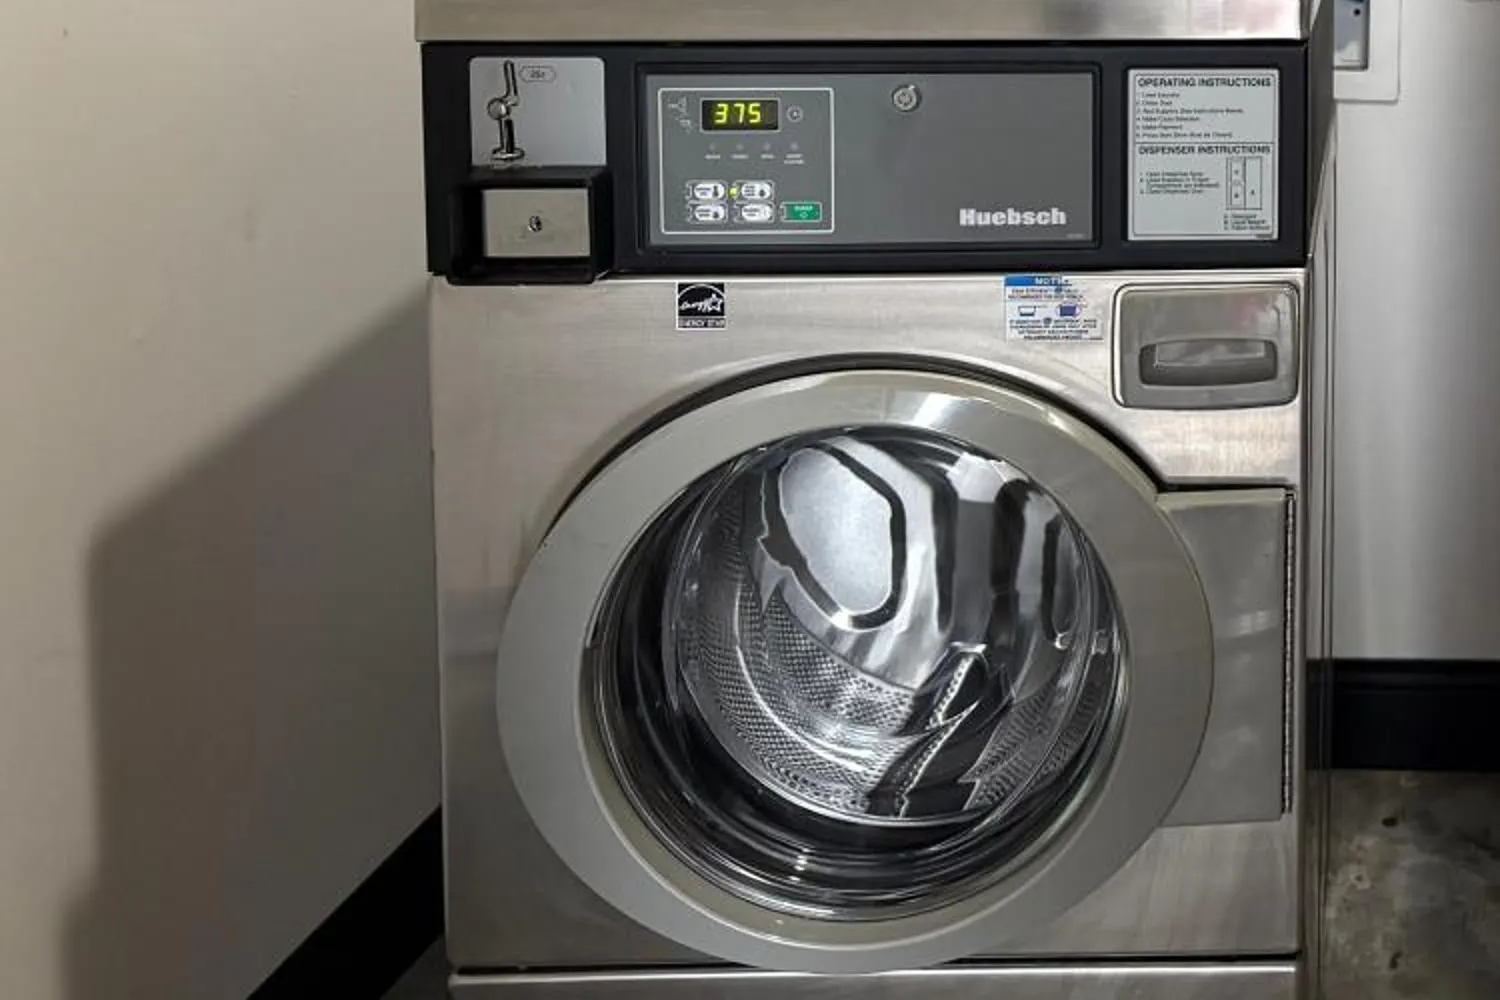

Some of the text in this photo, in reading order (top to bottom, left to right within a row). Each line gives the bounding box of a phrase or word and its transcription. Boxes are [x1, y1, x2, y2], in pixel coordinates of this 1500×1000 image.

[1137, 77, 1272, 88] OPERATING INSTRUCTIONS
[714, 103, 762, 124] 375
[1137, 145, 1271, 155] DISPENSER INSTRUCTIONS
[958, 207, 1068, 227] Huebsch
